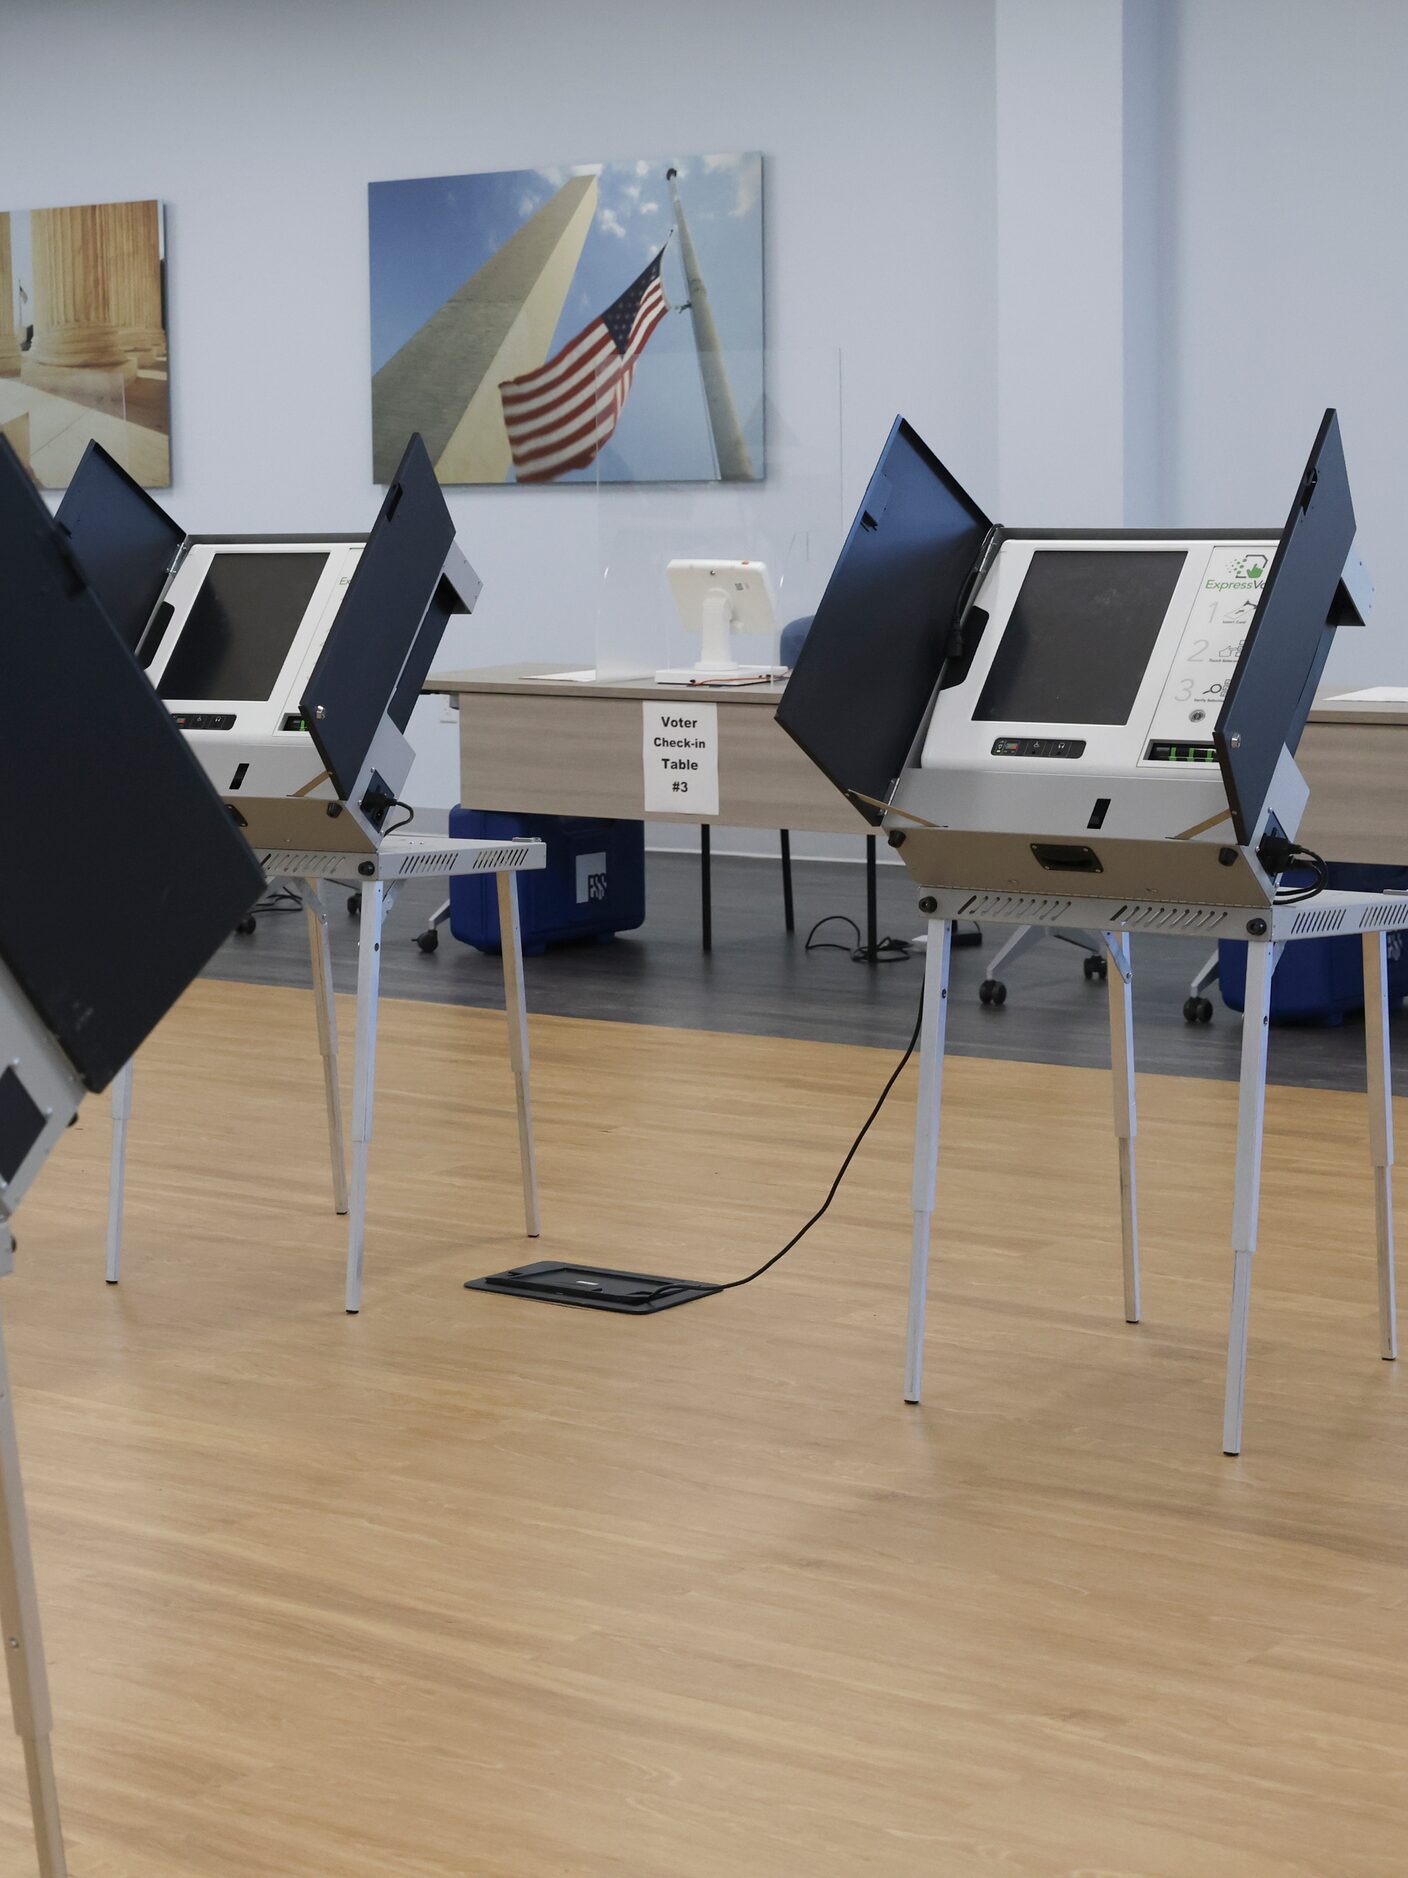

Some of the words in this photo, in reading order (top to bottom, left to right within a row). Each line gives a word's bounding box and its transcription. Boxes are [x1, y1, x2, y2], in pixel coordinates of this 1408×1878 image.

[1209, 601, 1219, 623] 1
[1187, 639, 1209, 662] 2
[1174, 678, 1195, 702] 3
[661, 716, 699, 729] Voter
[653, 737, 706, 749] Check-in
[661, 758, 699, 771] Table
[672, 781, 688, 793] #3
